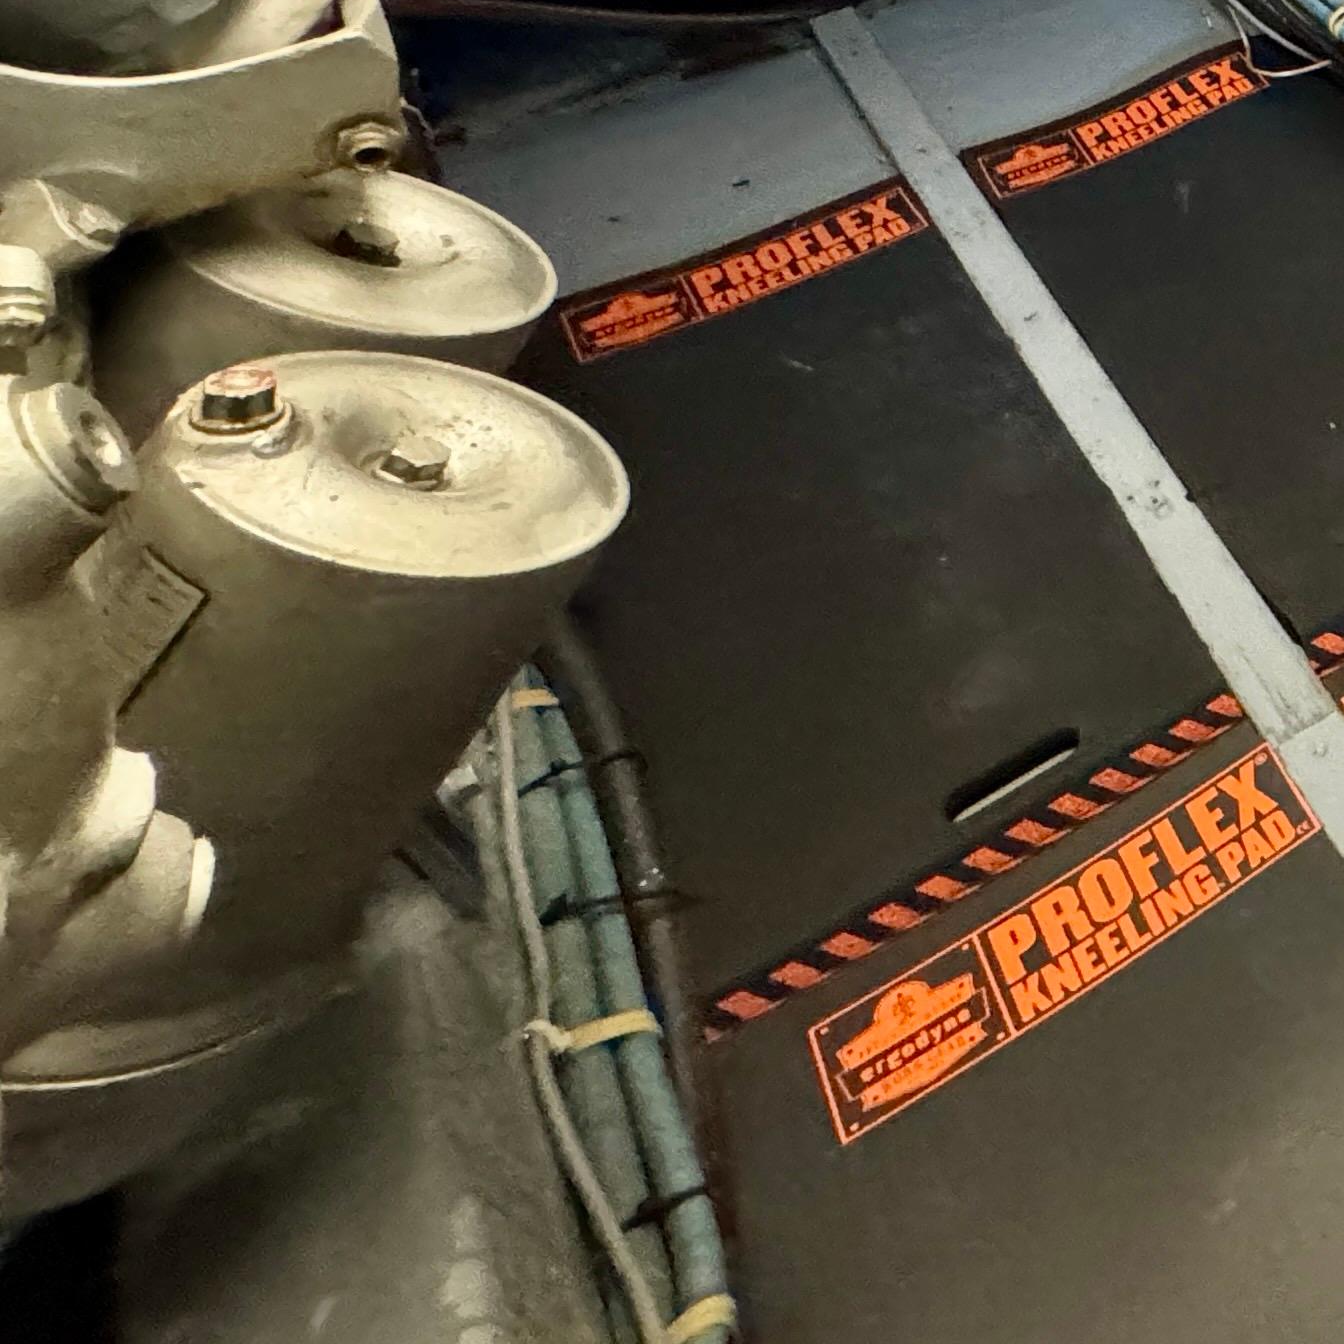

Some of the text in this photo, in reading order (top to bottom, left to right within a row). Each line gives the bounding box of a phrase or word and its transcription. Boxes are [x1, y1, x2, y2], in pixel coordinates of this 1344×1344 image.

[1076, 59, 1246, 147] PROFLEX
[1089, 77, 1254, 161] KNEELING PAD
[690, 196, 902, 297] PROFLEX
[702, 219, 913, 314] KNEELING PAD
[987, 758, 1279, 987] PROFLEX
[1008, 809, 1299, 1024] KNEELING PAD
